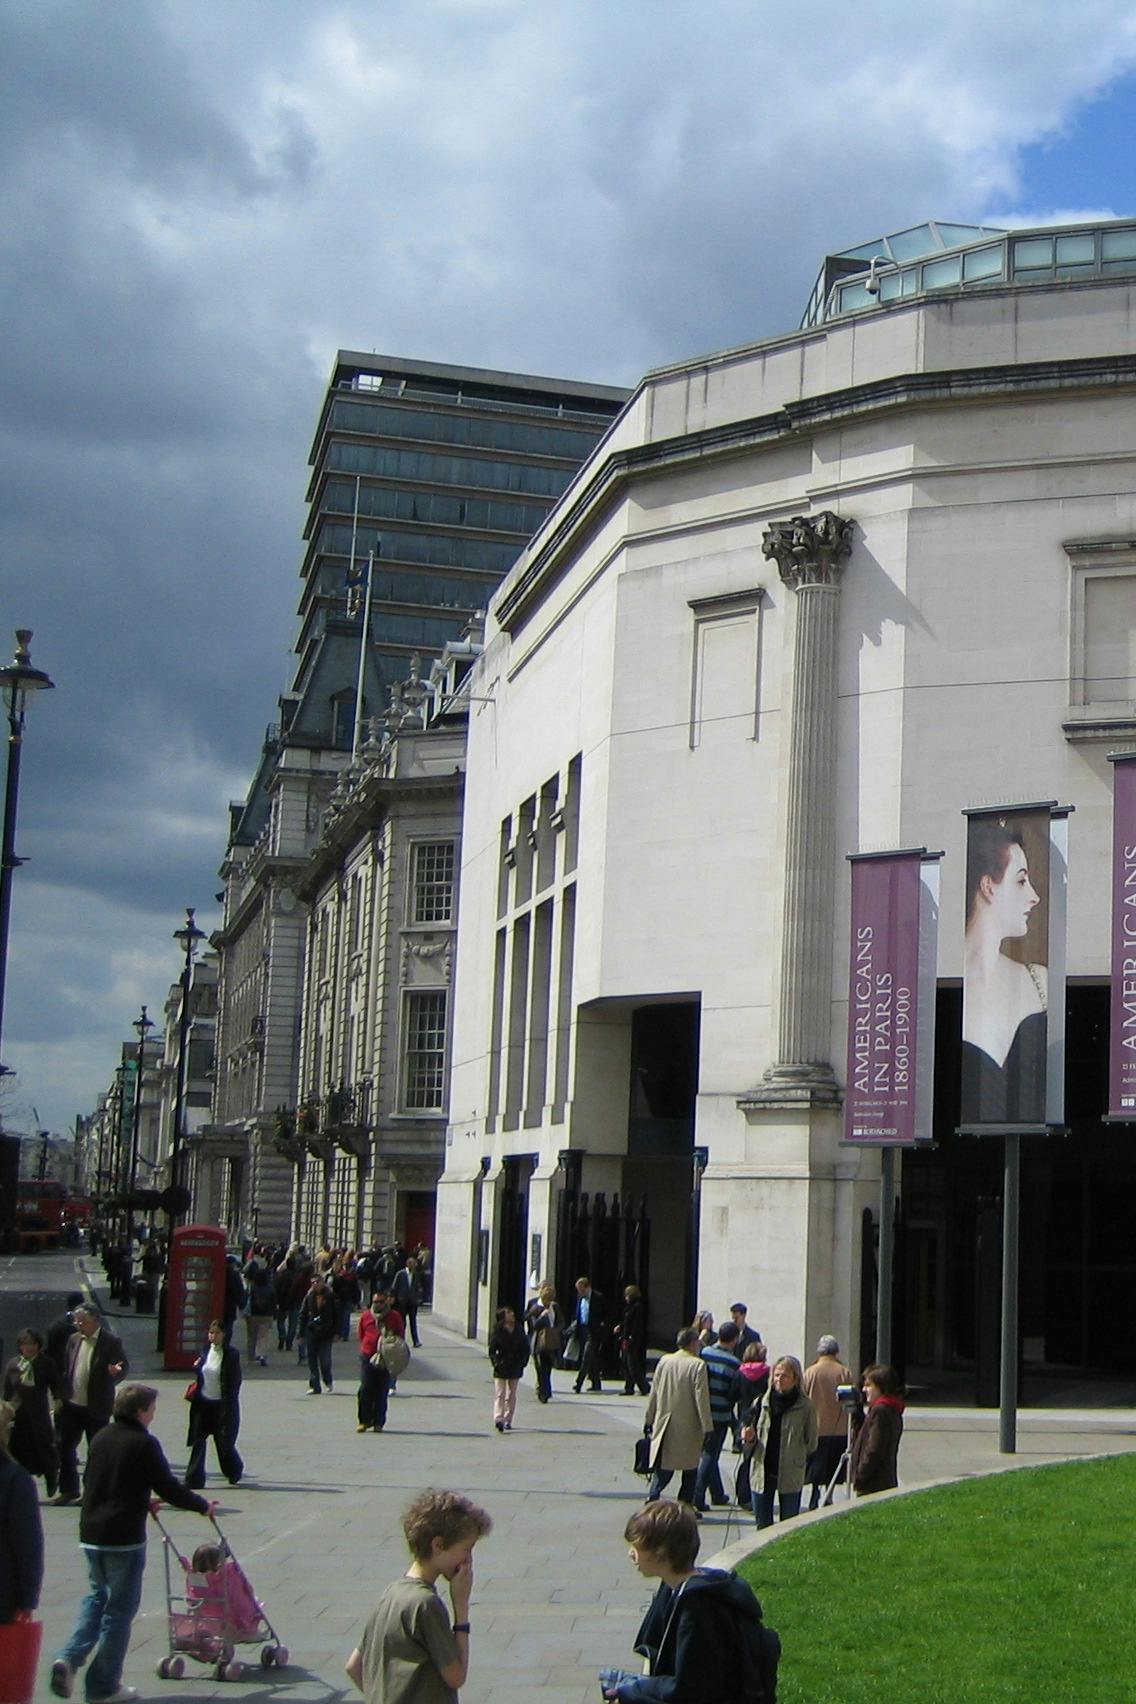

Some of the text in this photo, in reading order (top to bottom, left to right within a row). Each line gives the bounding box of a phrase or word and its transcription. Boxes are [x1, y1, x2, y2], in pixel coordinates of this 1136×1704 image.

[854, 926, 874, 1094] AMERICANS
[874, 972, 893, 1093] IN PARIS
